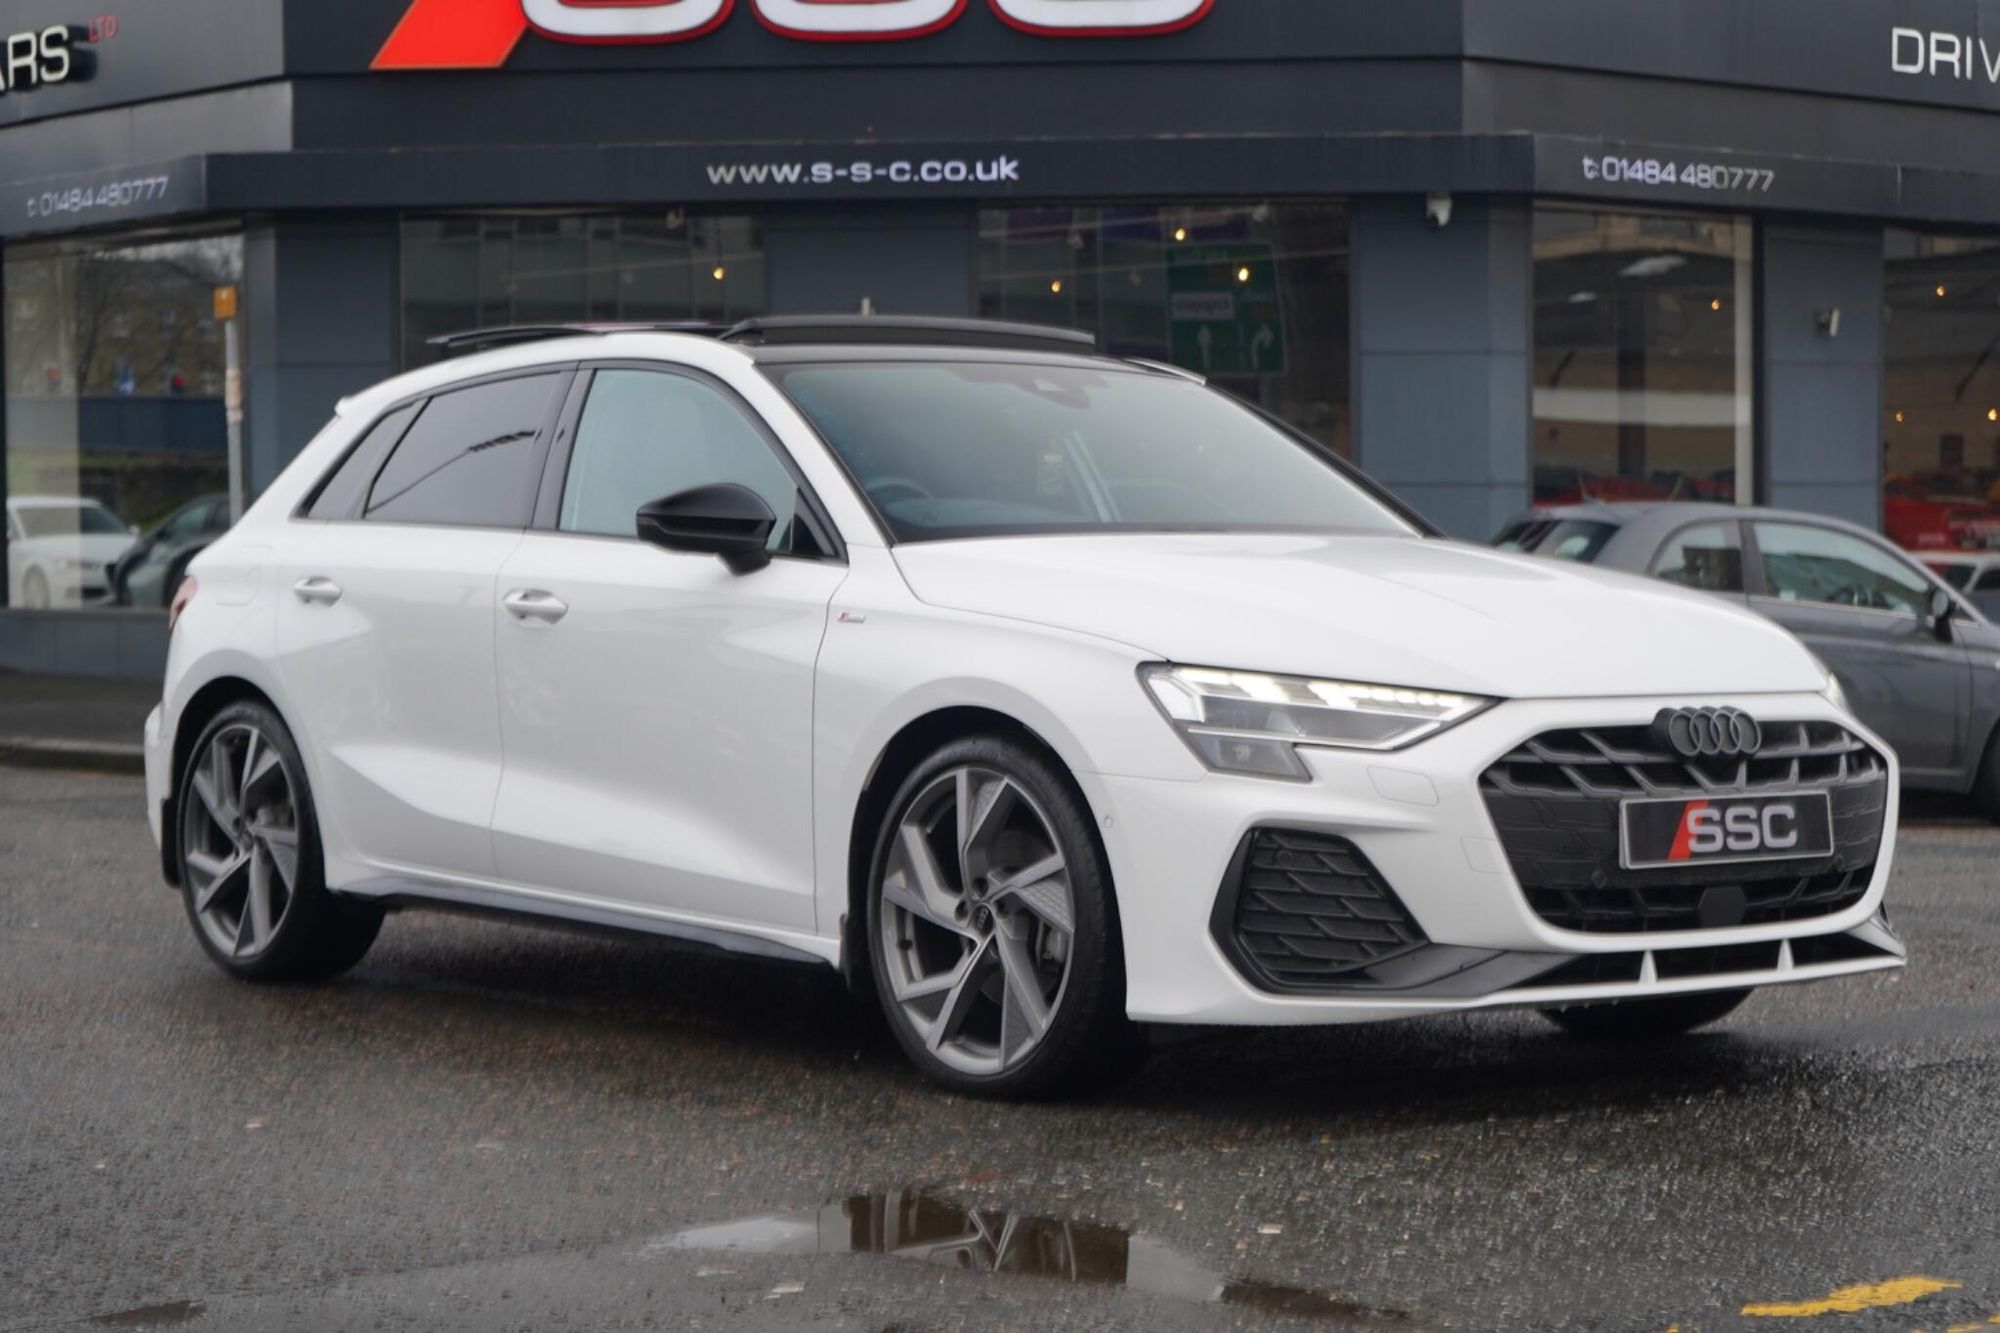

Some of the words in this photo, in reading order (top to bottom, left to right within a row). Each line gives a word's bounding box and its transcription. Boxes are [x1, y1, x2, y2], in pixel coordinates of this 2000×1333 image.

[88, 15, 117, 43] LTD
[0, 25, 69, 91] RS
[706, 156, 1019, 184] www.s-s-c.co.uk
[1680, 163, 1775, 192] 480777
[1686, 805, 1798, 852] SSC
